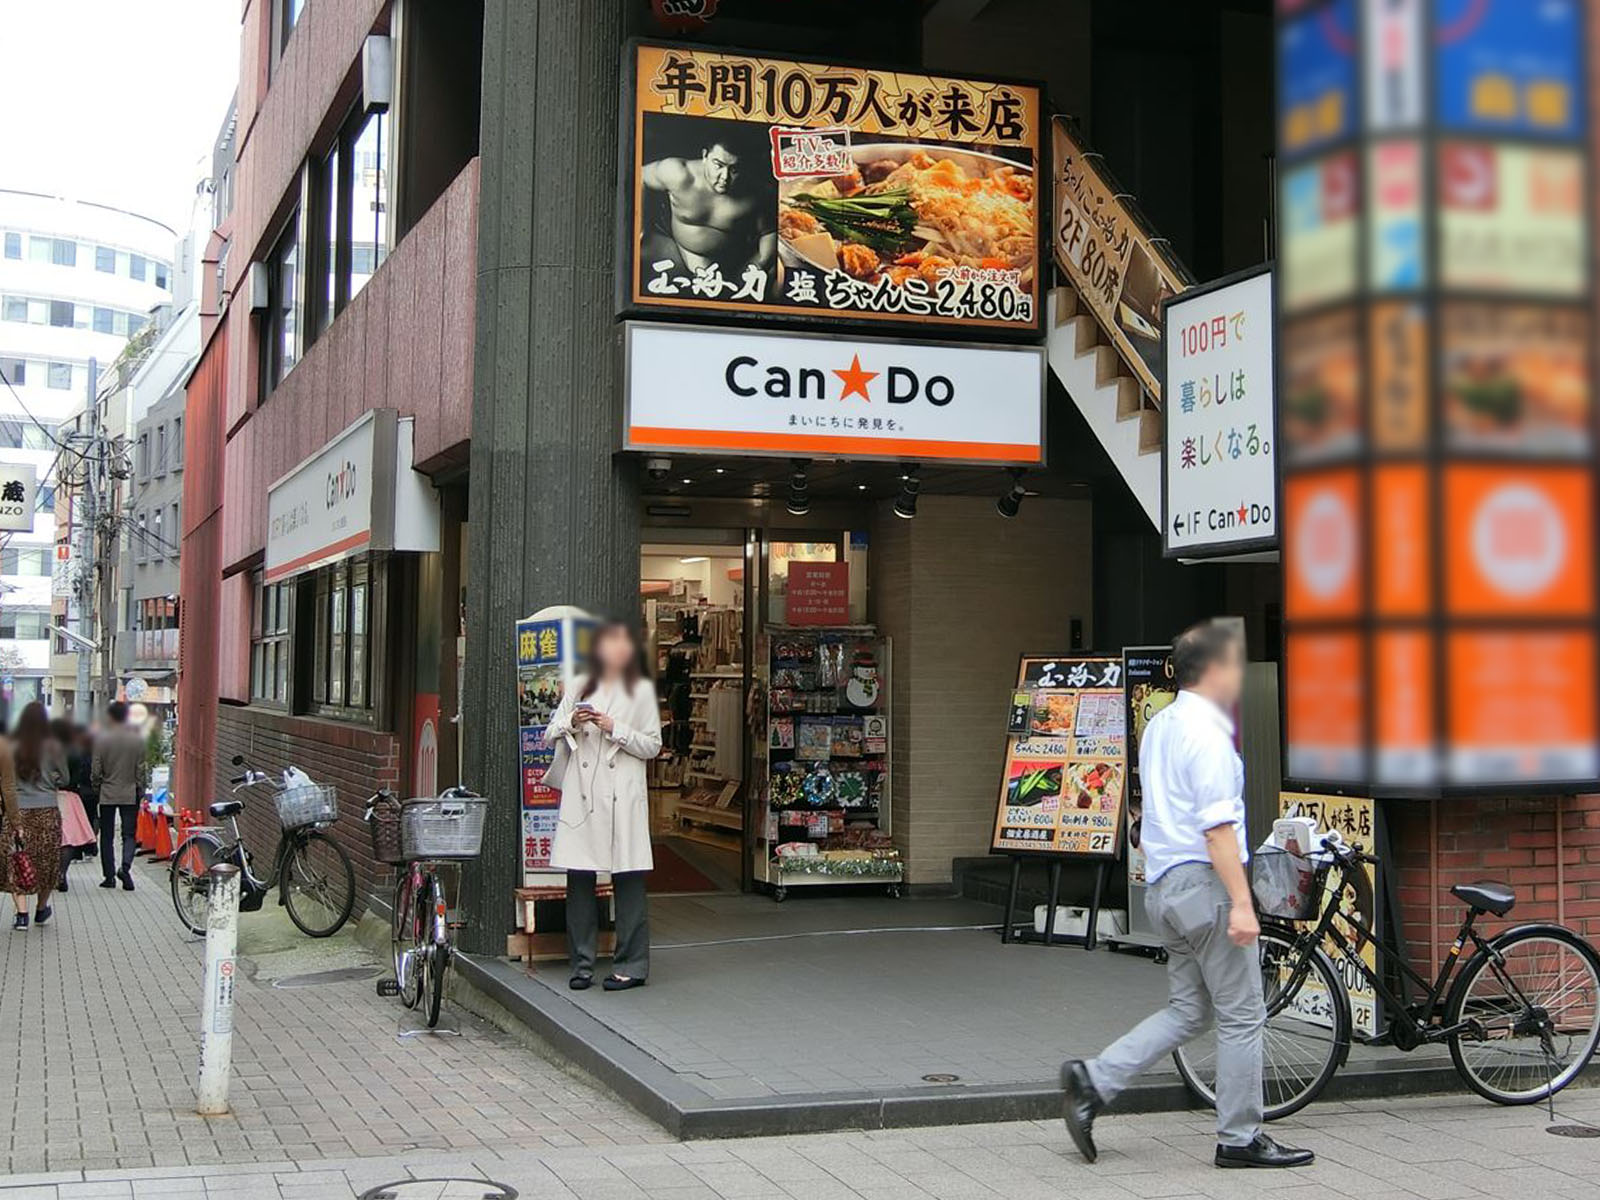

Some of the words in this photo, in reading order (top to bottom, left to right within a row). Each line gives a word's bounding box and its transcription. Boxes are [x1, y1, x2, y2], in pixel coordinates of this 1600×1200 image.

[656, 56, 1023, 141] 年間10万人が来店
[1181, 311, 1246, 358] 100円で
[1180, 369, 1246, 414] 暮らしは
[788, 414, 904, 431] まいにちに発見を。
[1181, 424, 1270, 469] 楽しくなる。
[519, 628, 558, 660] 麻雀
[1091, 835, 1112, 850] 2F
[1356, 1007, 1371, 1026] 2F
